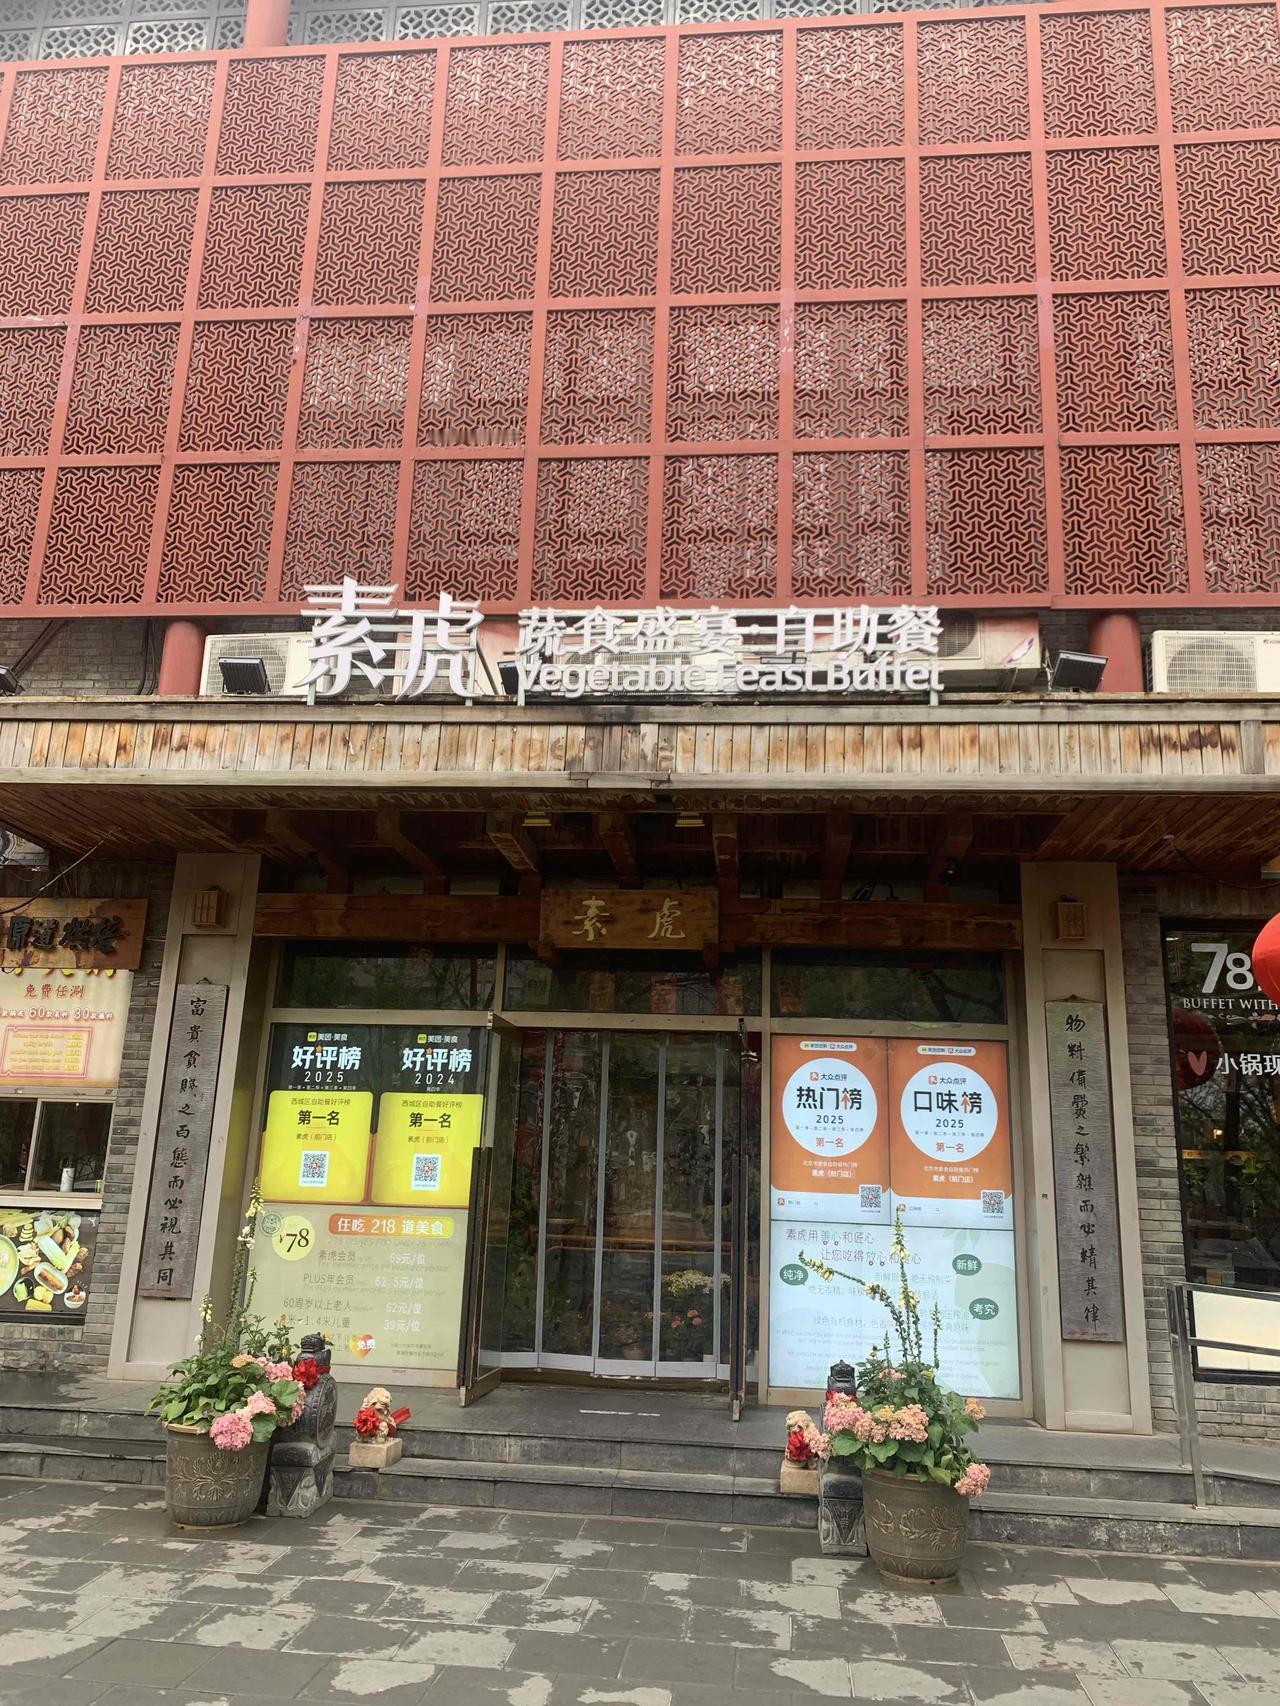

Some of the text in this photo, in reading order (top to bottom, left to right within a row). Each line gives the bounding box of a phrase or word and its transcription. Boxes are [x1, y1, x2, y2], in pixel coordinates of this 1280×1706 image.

[290, 575, 484, 699] 素虎
[516, 604, 944, 658] 蔬食盛宴·自助餐
[516, 656, 944, 699] Vegetable Feast Buffet
[572, 896, 686, 942] 素虎
[1183, 998, 1235, 1010] BUFFET
[291, 1045, 362, 1071] 好评榜
[401, 1047, 473, 1073] 好评榜
[304, 1071, 345, 1083] 2025
[415, 1073, 455, 1085] 2024
[820, 1073, 848, 1082] 大众点评
[939, 1076, 967, 1085] 大众点评
[796, 1086, 862, 1111] 热门榜
[913, 1090, 982, 1114] 口味榜
[297, 1109, 340, 1126] 第一名
[408, 1111, 451, 1129] 第一名
[816, 1114, 844, 1125] 2025
[935, 1118, 964, 1129] 2025
[815, 1137, 844, 1148] 第一名
[935, 1142, 965, 1153] 第一名
[337, 1217, 444, 1236] 任吃 218 道美食
[956, 1257, 979, 1271] 新鲜
[782, 1268, 804, 1280] 纯净
[973, 1302, 997, 1315] 考究
